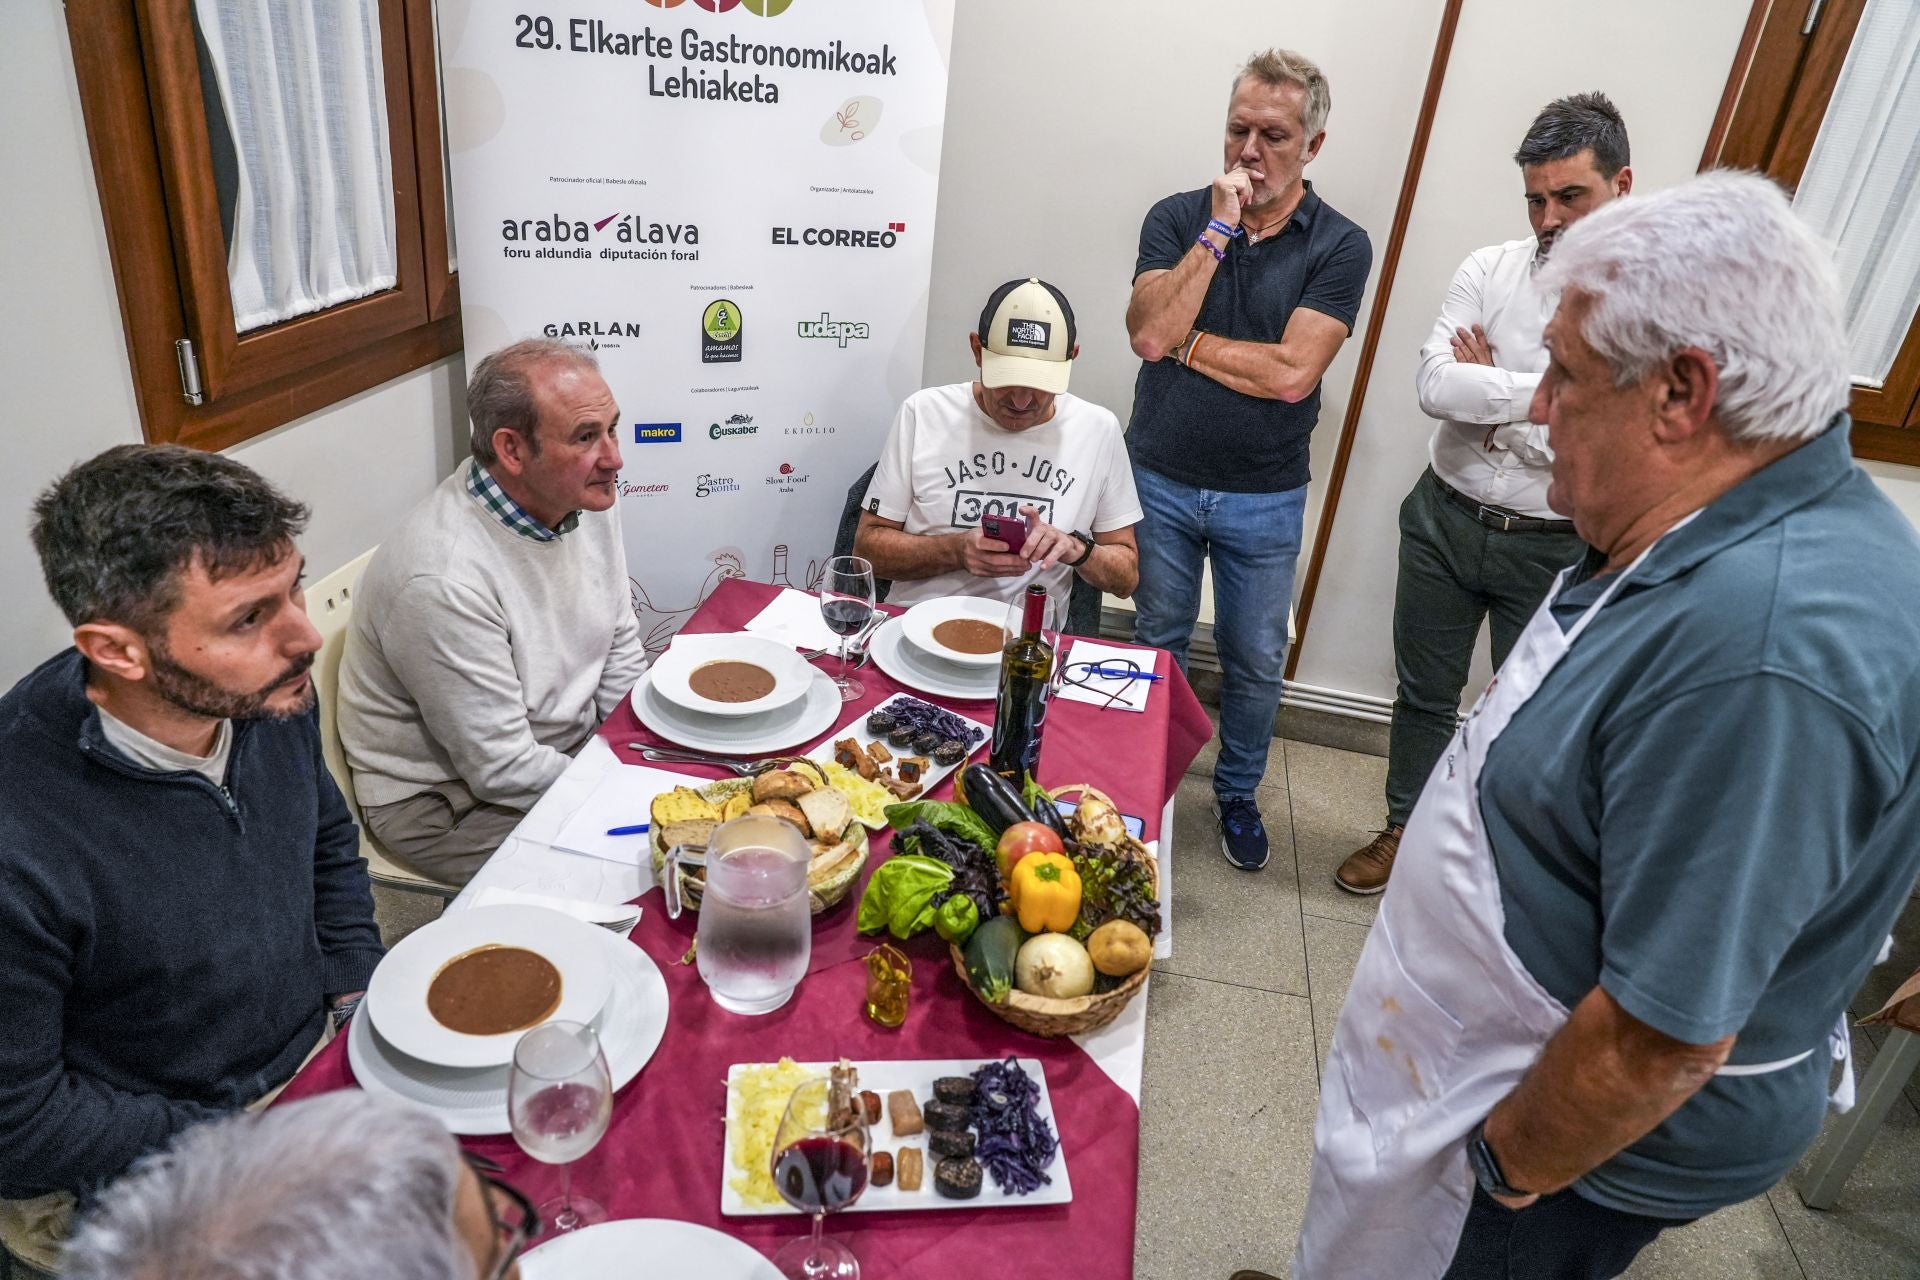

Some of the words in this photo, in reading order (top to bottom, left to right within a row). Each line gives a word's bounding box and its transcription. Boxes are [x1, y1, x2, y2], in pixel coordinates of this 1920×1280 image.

[515, 14, 562, 51] 29.
[569, 18, 673, 58] Elkarte
[680, 28, 897, 76] Gastronomikoak
[648, 64, 779, 103] Lehiaketa
[549, 176, 585, 184] Patrocinador
[809, 185, 840, 193] Organizador
[502, 213, 589, 242] araba
[616, 214, 699, 244] álava
[772, 227, 799, 245] EL
[802, 228, 897, 249] CORREO
[503, 246, 531, 258] foru
[535, 247, 592, 259] aldundia
[599, 247, 667, 261] diputación
[671, 249, 699, 261] foral
[543, 321, 641, 338] GARLAN
[798, 312, 869, 348] udapa
[1011, 326, 1035, 335] NORTH
[1017, 333, 1035, 341] FACE
[640, 428, 676, 437] makro
[709, 423, 759, 440] euskaber
[784, 427, 835, 435] EKIOLIO
[765, 476, 784, 485] Slow
[787, 475, 807, 483] Food
[711, 484, 740, 493] kontu
